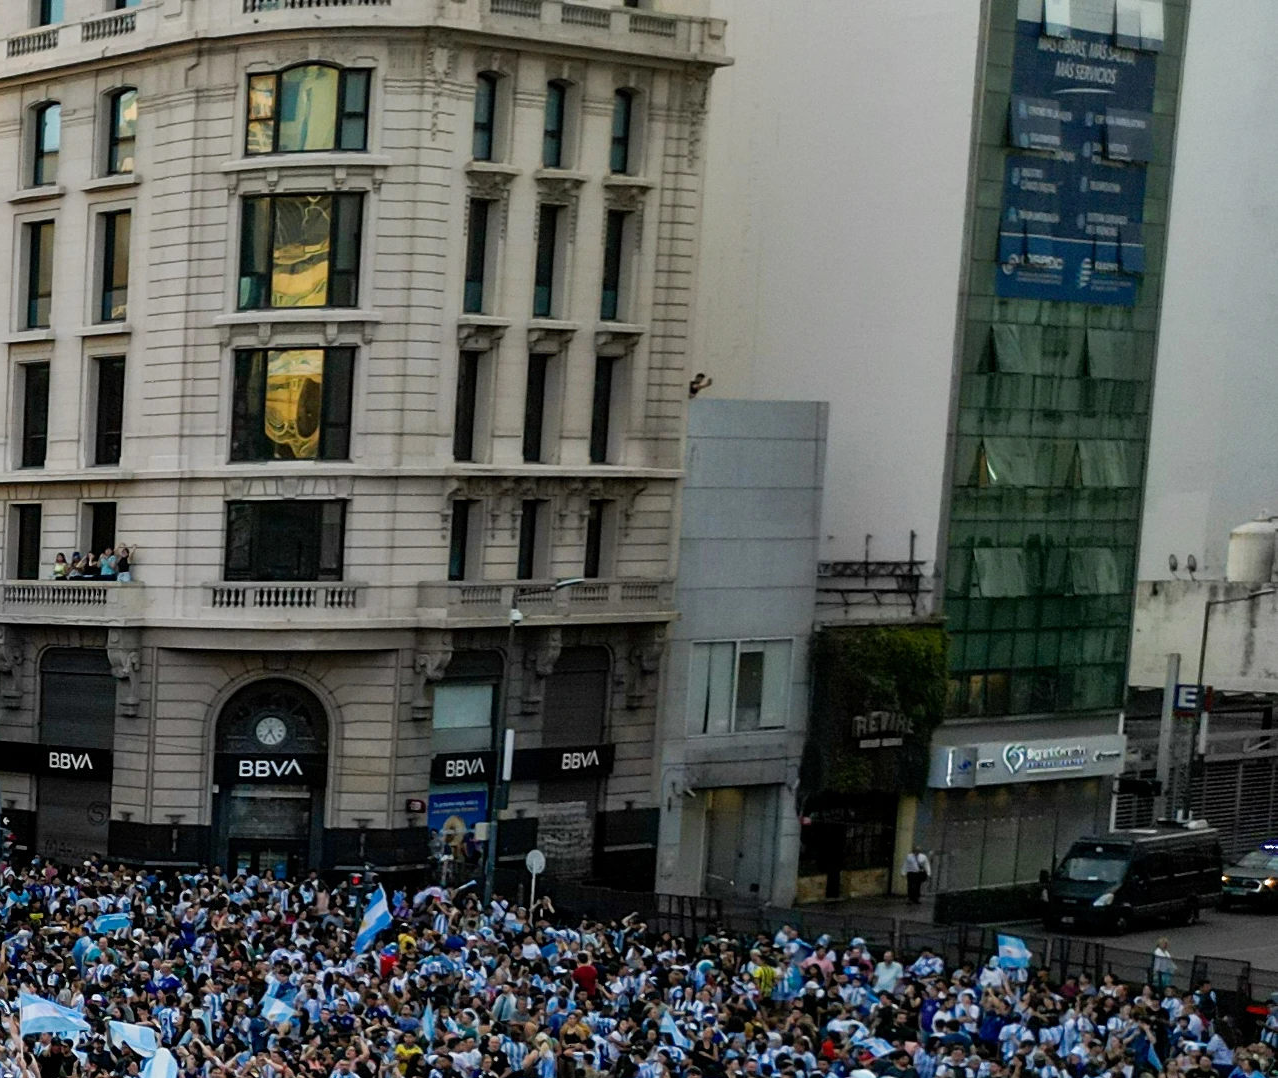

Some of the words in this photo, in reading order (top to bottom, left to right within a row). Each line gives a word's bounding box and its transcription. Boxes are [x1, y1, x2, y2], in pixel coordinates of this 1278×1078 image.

[48, 752, 94, 771] BBVA
[238, 758, 304, 777] BBVA
[445, 757, 485, 778] BBVA
[561, 749, 599, 770] BBVA
